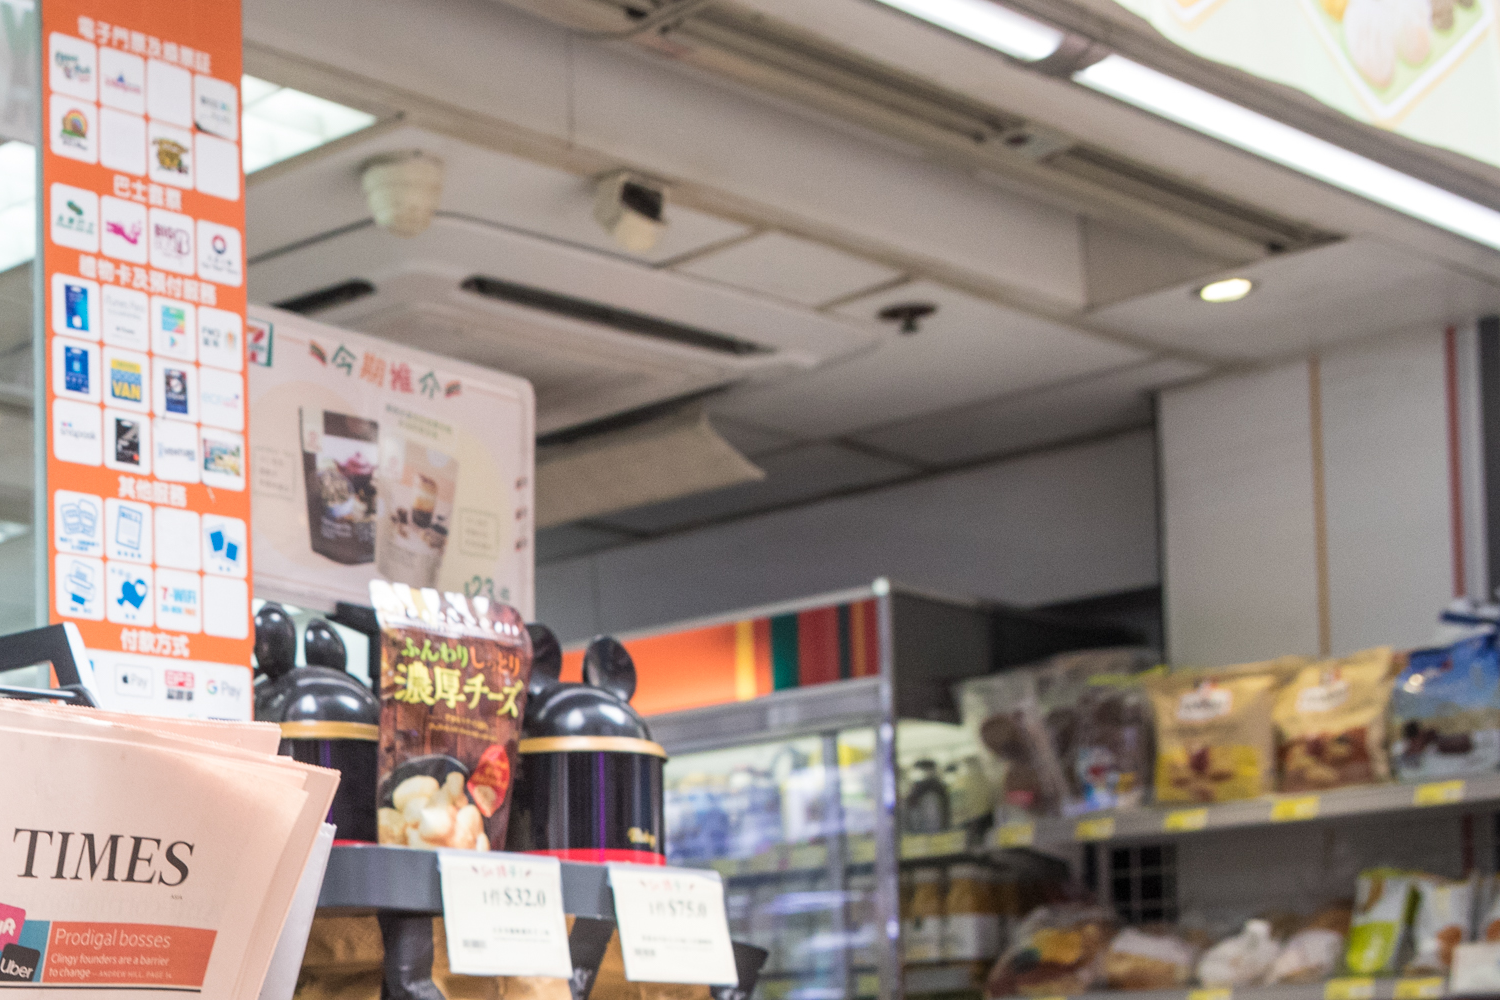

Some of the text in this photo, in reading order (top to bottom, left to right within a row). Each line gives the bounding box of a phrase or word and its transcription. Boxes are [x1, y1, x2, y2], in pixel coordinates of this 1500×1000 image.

[117, 475, 188, 508] 其他服務
[119, 628, 191, 659] 付款方式
[394, 660, 525, 719] 濃厚チーズ
[12, 827, 196, 888] TIMES
[503, 886, 547, 909] $32.0
[54, 928, 172, 951] Prodigal bosses
[0, 957, 35, 980] Uber
[50, 953, 79, 967] Clingy
[80, 953, 117, 966] founders
[118, 957, 133, 965] are
[139, 955, 171, 967] barrier
[49, 968, 59, 978] to
[59, 968, 91, 980] change
